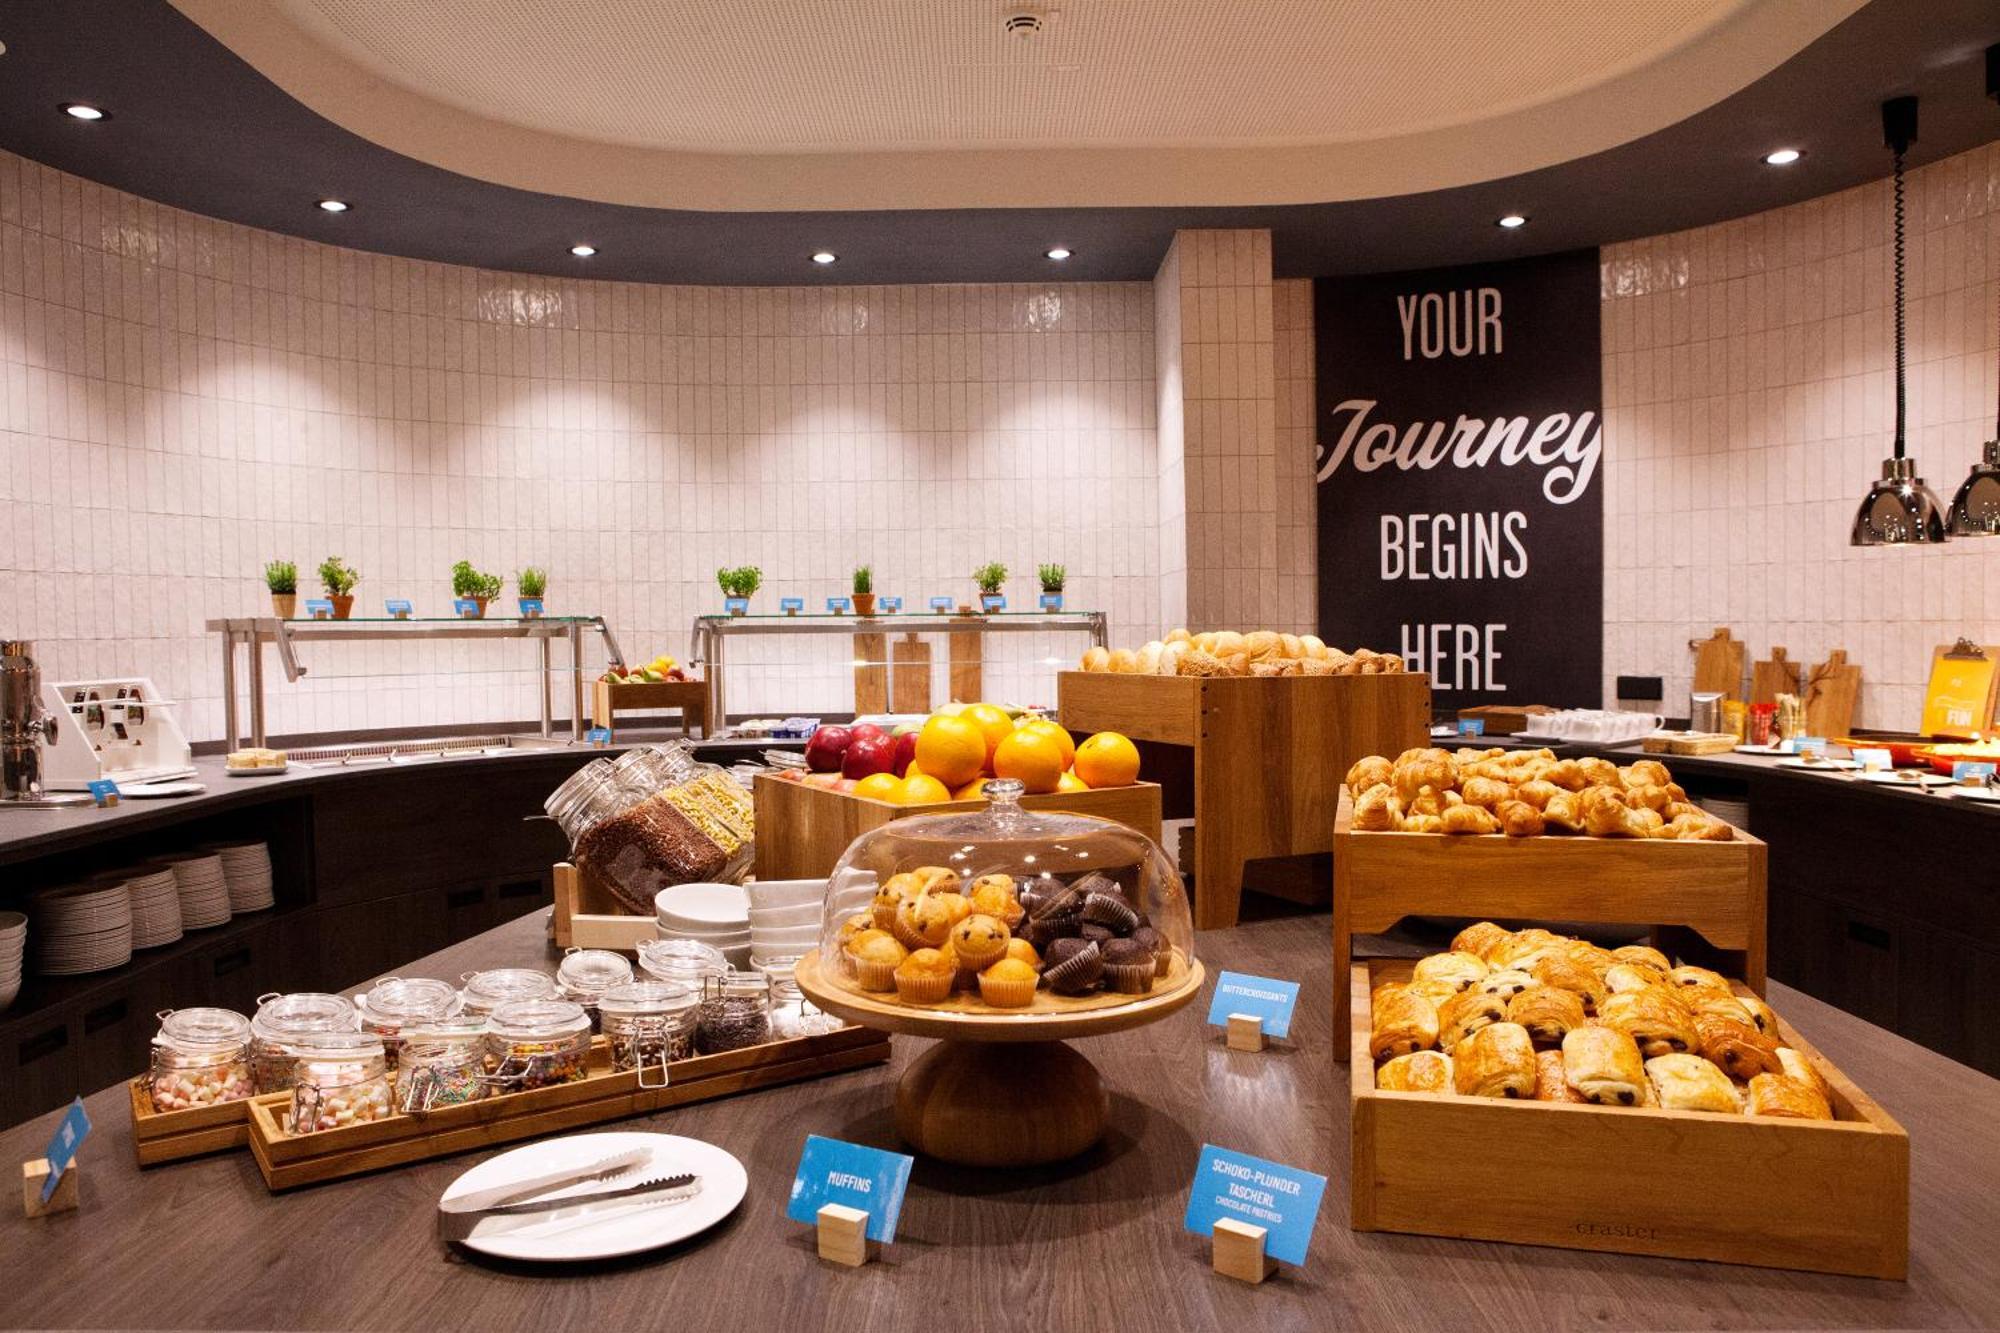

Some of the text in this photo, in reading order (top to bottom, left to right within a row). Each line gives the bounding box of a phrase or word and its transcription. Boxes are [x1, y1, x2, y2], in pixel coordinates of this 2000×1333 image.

[1398, 288, 1503, 361] YOUR
[1317, 399, 1602, 506] Journey
[1380, 511, 1529, 581] BEGINS
[1402, 624, 1508, 692] HERE
[828, 1170, 873, 1194] MUFFINS
[1212, 1158, 1302, 1197] SCHOKO-PLUNDER
[1228, 1182, 1276, 1209] TASCHERL
